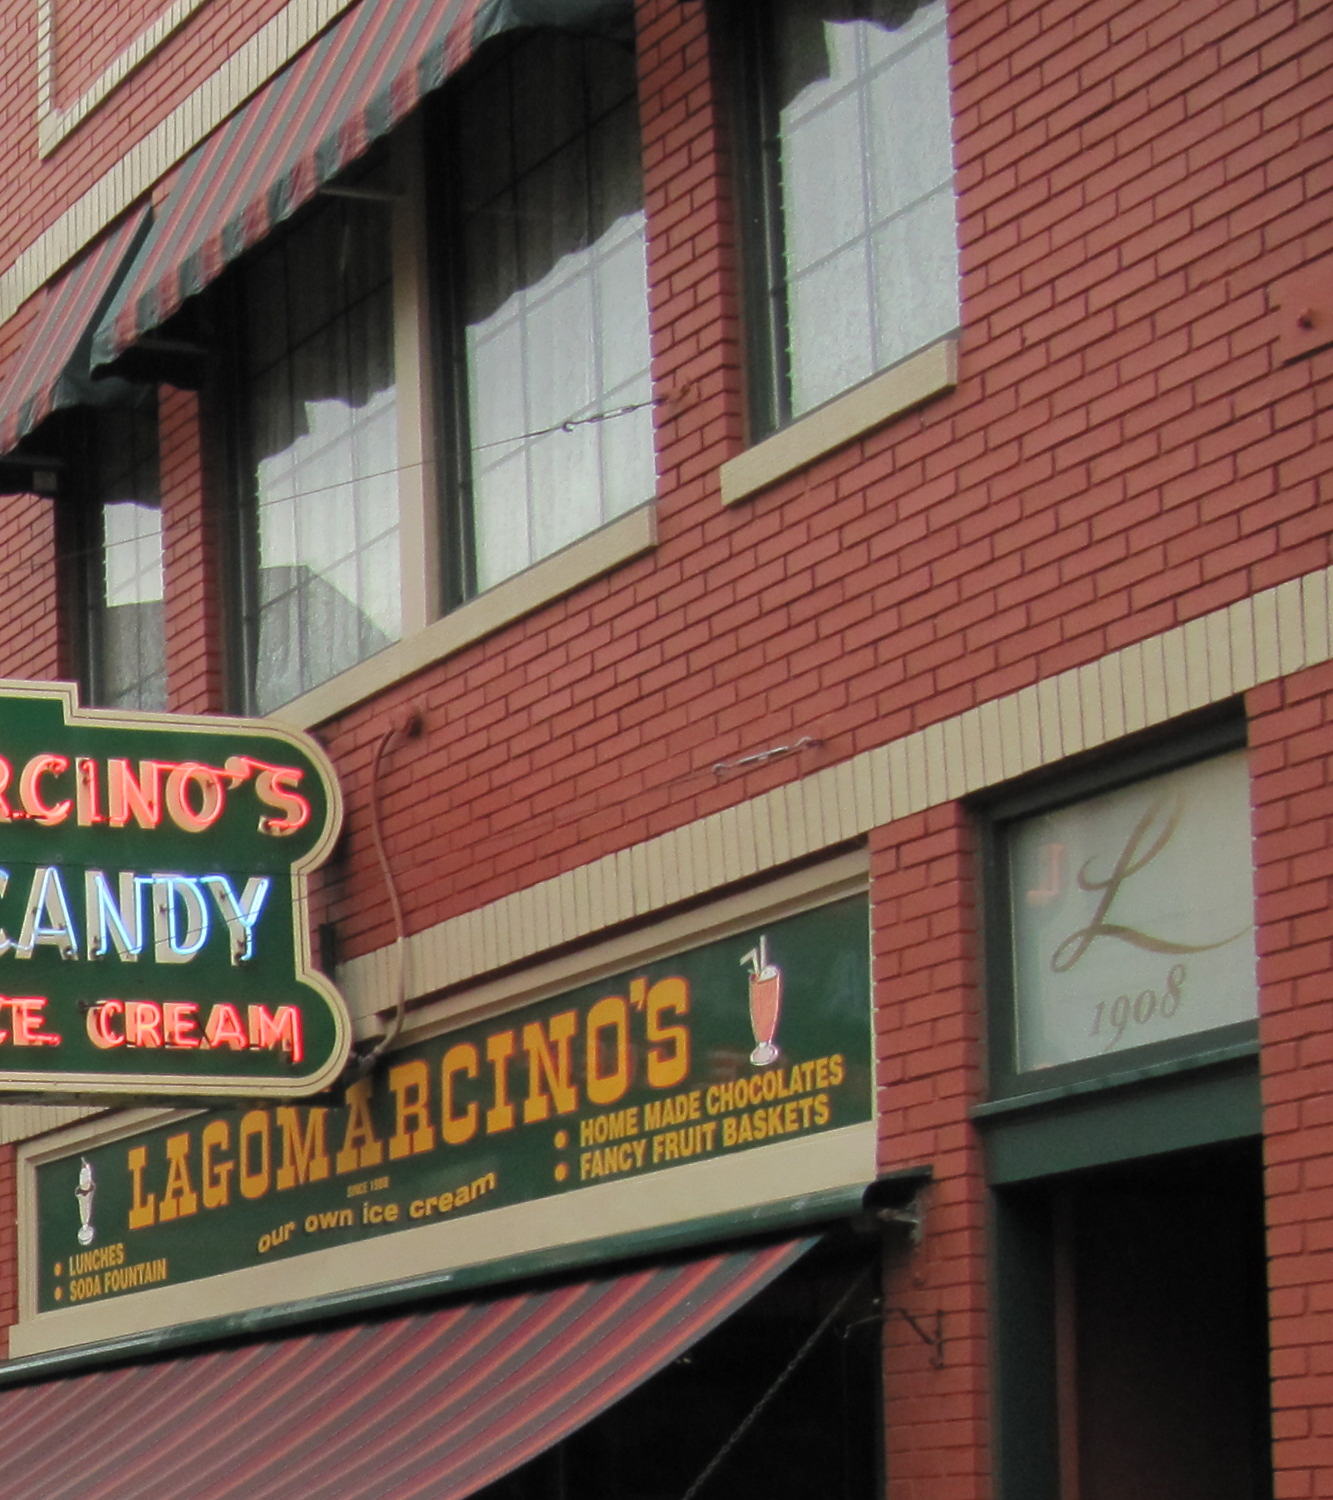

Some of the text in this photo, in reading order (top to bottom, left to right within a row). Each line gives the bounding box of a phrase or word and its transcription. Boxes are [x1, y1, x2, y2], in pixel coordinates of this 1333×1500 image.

[85, 999, 302, 1062] CREAM
[1087, 963, 1187, 1052] 1908
[128, 975, 690, 1230] LAGOMARCINO'S
[580, 1054, 845, 1147] HOME MADE CHOCOLATES
[580, 1093, 830, 1180] FANCY FRUIT BASKETS
[258, 1172, 497, 1253] our own ice cream
[69, 1242, 124, 1277] LUNCHES
[69, 1258, 167, 1301] SODA FOUNTAIN
